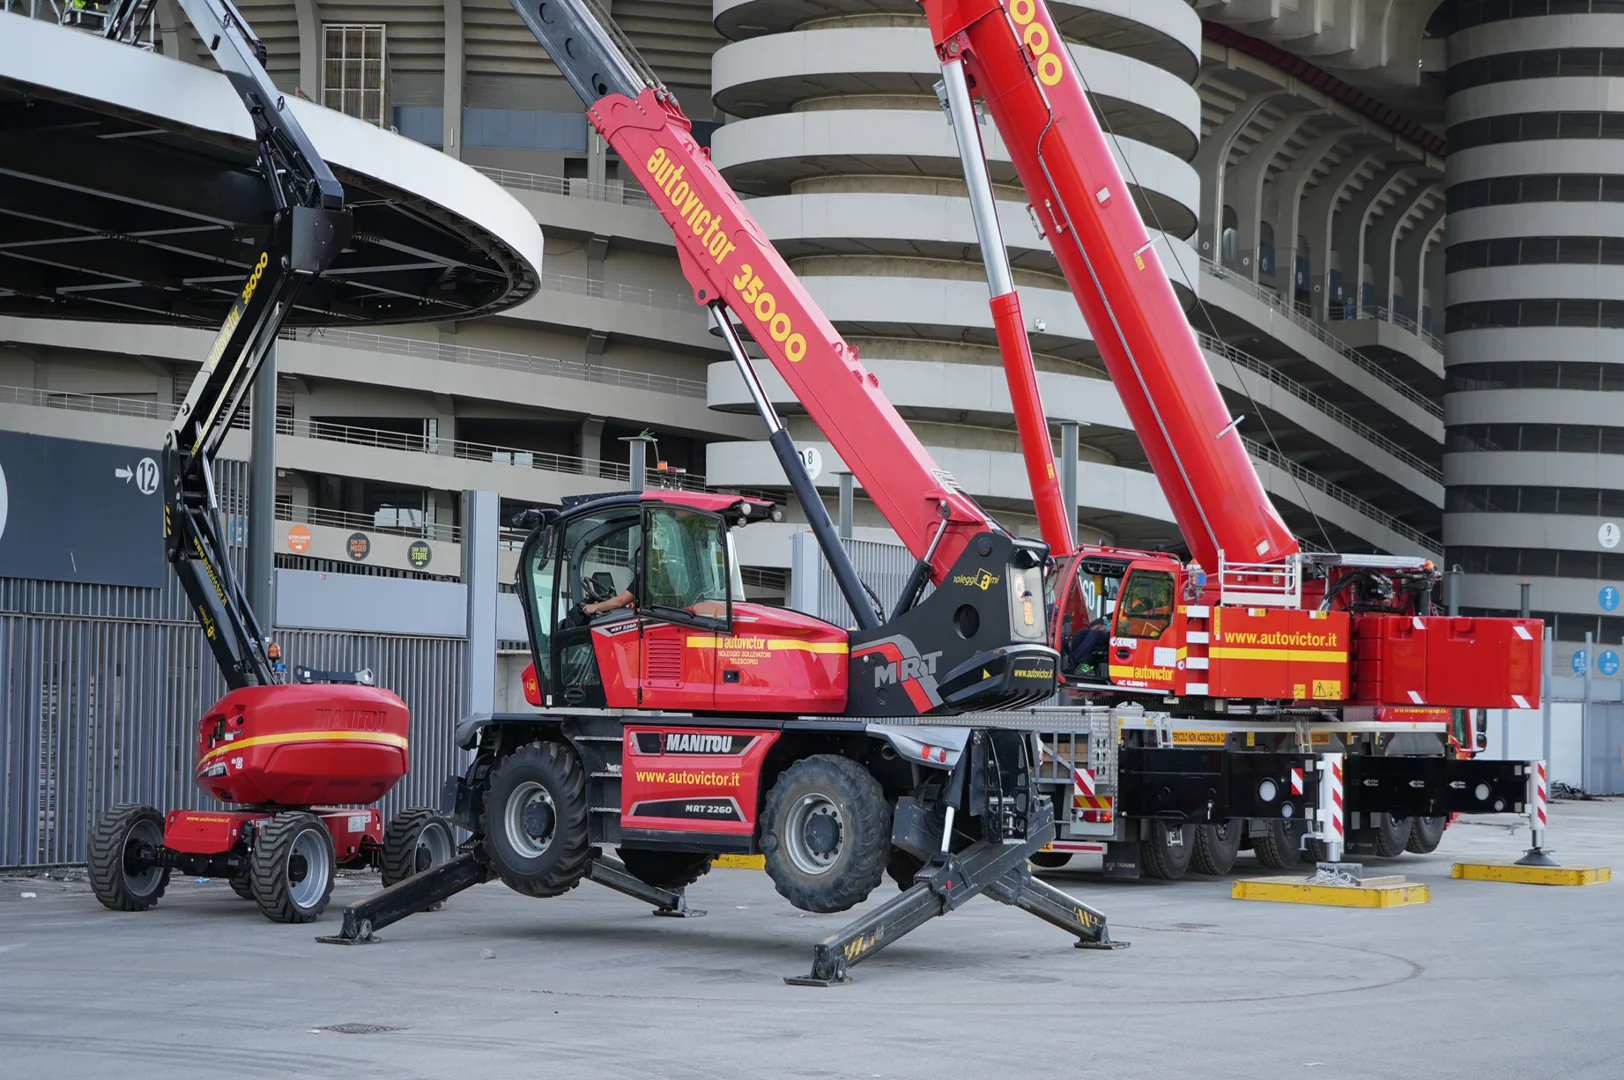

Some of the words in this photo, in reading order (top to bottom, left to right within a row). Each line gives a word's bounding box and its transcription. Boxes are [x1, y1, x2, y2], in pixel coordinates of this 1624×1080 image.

[647, 147, 736, 264] autovictor
[733, 264, 807, 362] 35000
[242, 251, 268, 305] 35000
[807, 450, 814, 465] 8
[140, 461, 156, 491] 12
[1606, 525, 1612, 537] 9
[724, 635, 766, 650] autovictor
[1224, 631, 1337, 647] www.autovictor.it
[874, 650, 943, 688] MRT
[1014, 668, 1053, 678] www.autovictor.it
[1134, 665, 1174, 680] autovictor
[316, 708, 387, 732] MANITOU
[667, 734, 732, 753] MANITOU
[636, 771, 740, 787] www.autovictor.it
[685, 804, 706, 813] MRT
[707, 805, 733, 814] 2260
